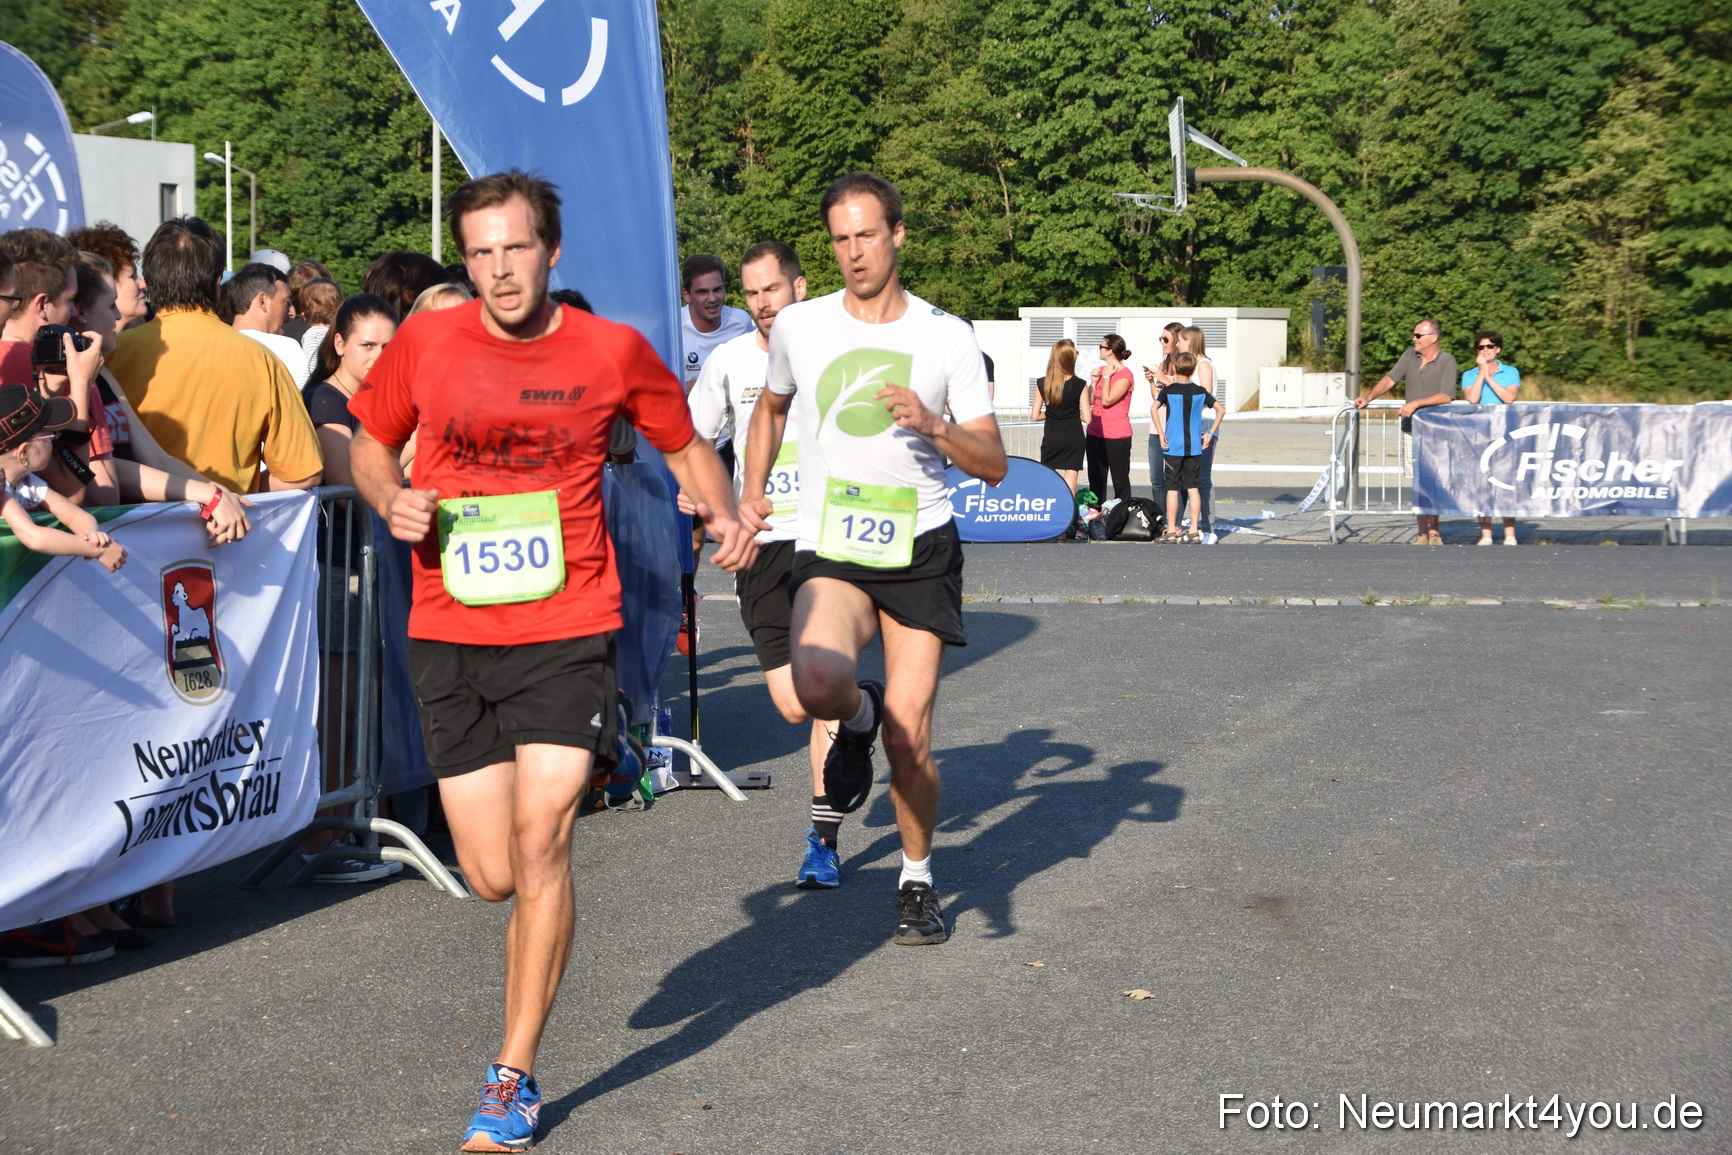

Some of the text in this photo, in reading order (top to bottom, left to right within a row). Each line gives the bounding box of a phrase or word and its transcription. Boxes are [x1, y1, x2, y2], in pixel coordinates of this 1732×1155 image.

[519, 389, 565, 401] swn
[61, 448, 86, 474] SONY
[1516, 451, 1683, 482] Fischer
[965, 493, 1056, 513] Fischer
[1530, 486, 1669, 499] AUTOMOBILE
[454, 513, 496, 524] irmenlauf
[842, 514, 895, 545] 129
[975, 513, 1050, 523] AUTOMOBILE
[454, 536, 549, 575] 1530
[184, 670, 213, 692] 1628
[133, 718, 265, 784] Neumarkter
[114, 761, 281, 858] Lammsbräu
